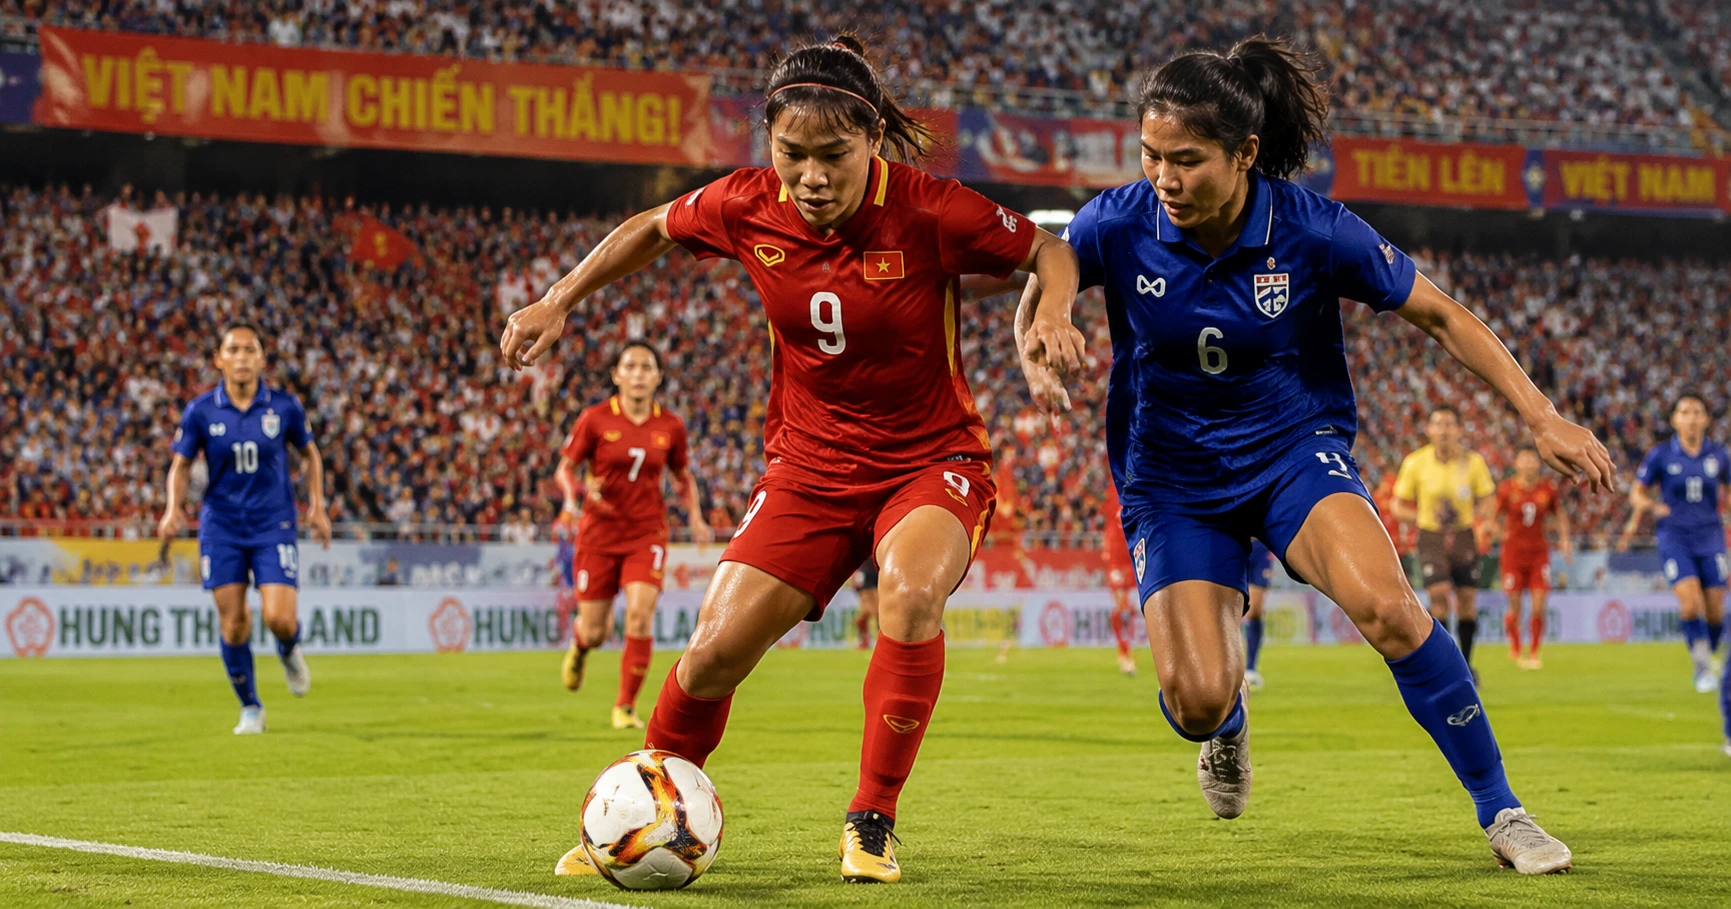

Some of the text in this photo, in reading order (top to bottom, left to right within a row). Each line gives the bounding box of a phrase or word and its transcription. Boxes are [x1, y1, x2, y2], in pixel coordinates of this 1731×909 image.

[82, 46, 681, 146] VIỆT NAM CHIẾN THẮNG!
[1439, 150, 1505, 195] LÊN
[1637, 163, 1716, 203] NAM
[809, 291, 847, 355] 9
[1197, 326, 1228, 375] 6
[231, 440, 259, 475] 10
[627, 447, 646, 483] 7
[650, 544, 664, 571] 7
[59, 606, 162, 647] HUNG
